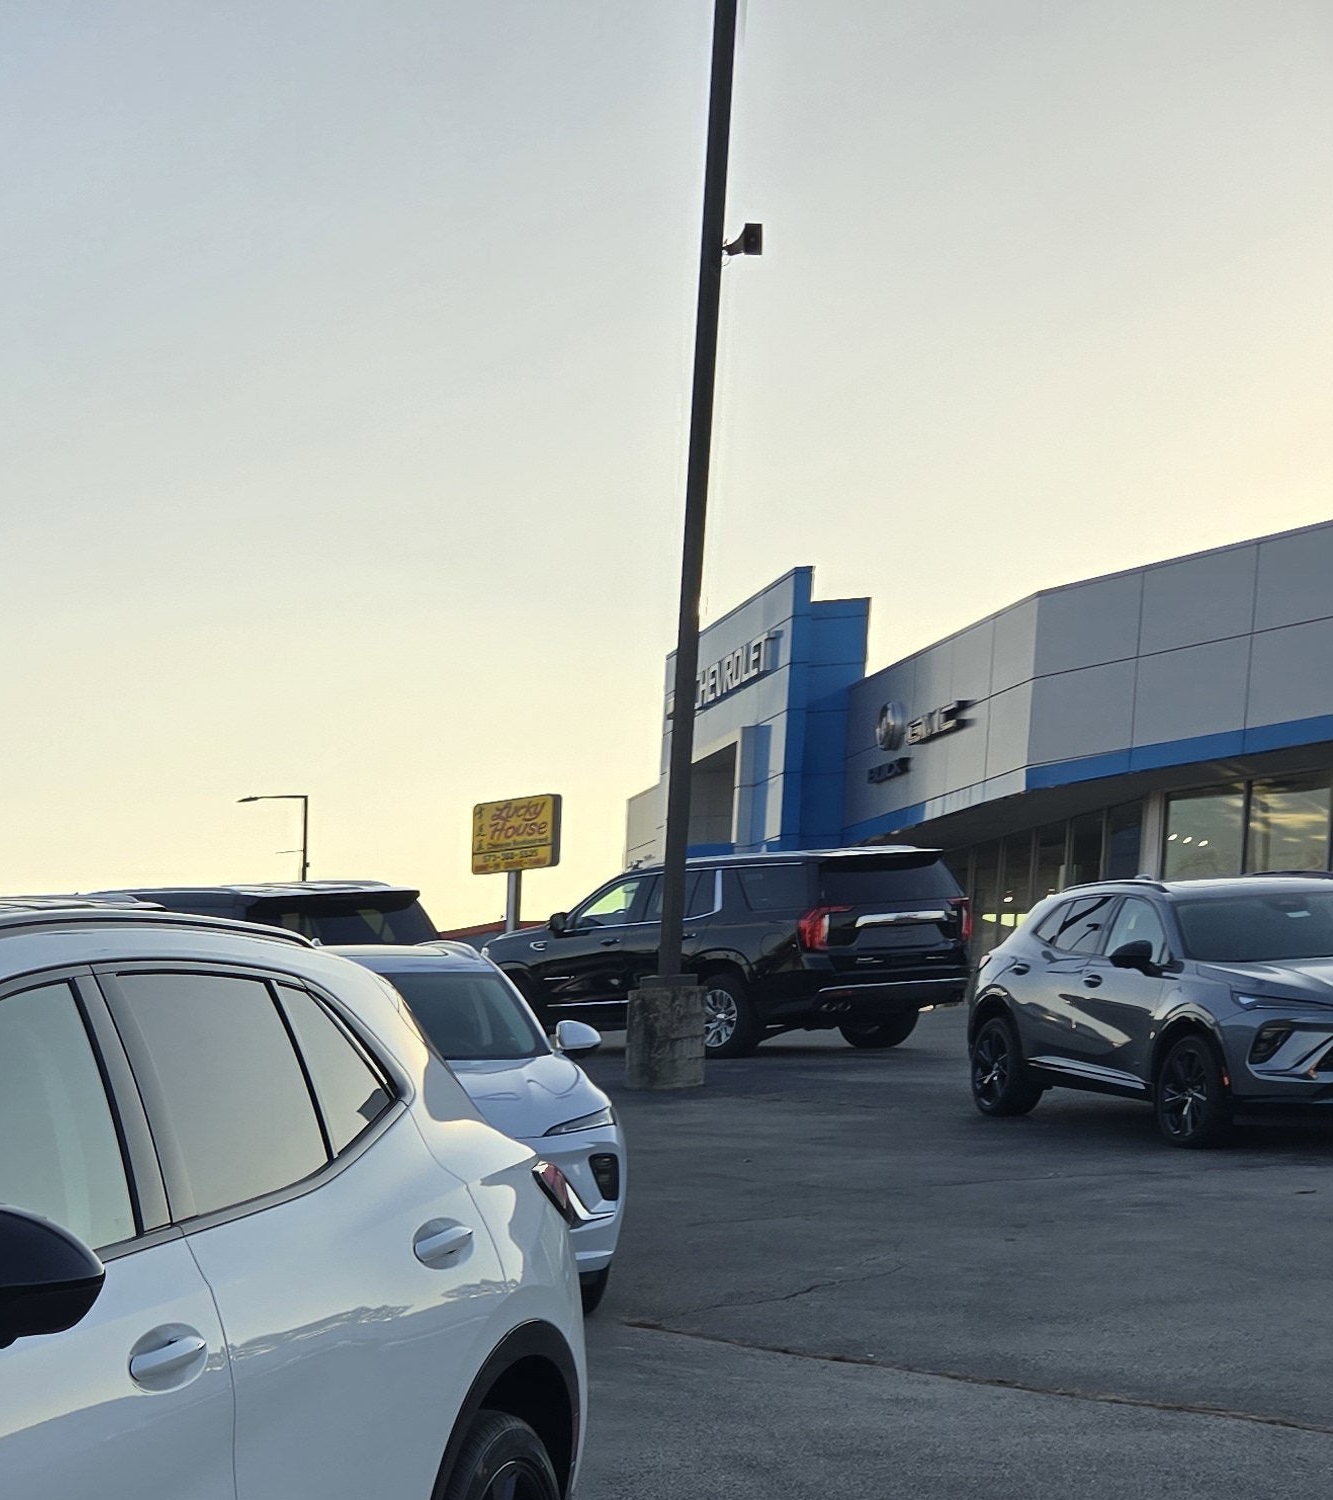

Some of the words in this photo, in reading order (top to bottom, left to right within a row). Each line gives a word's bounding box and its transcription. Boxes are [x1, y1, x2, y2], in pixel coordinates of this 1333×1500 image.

[906, 703, 957, 745] GMC
[492, 800, 547, 822] Lucky
[489, 820, 548, 840] House
